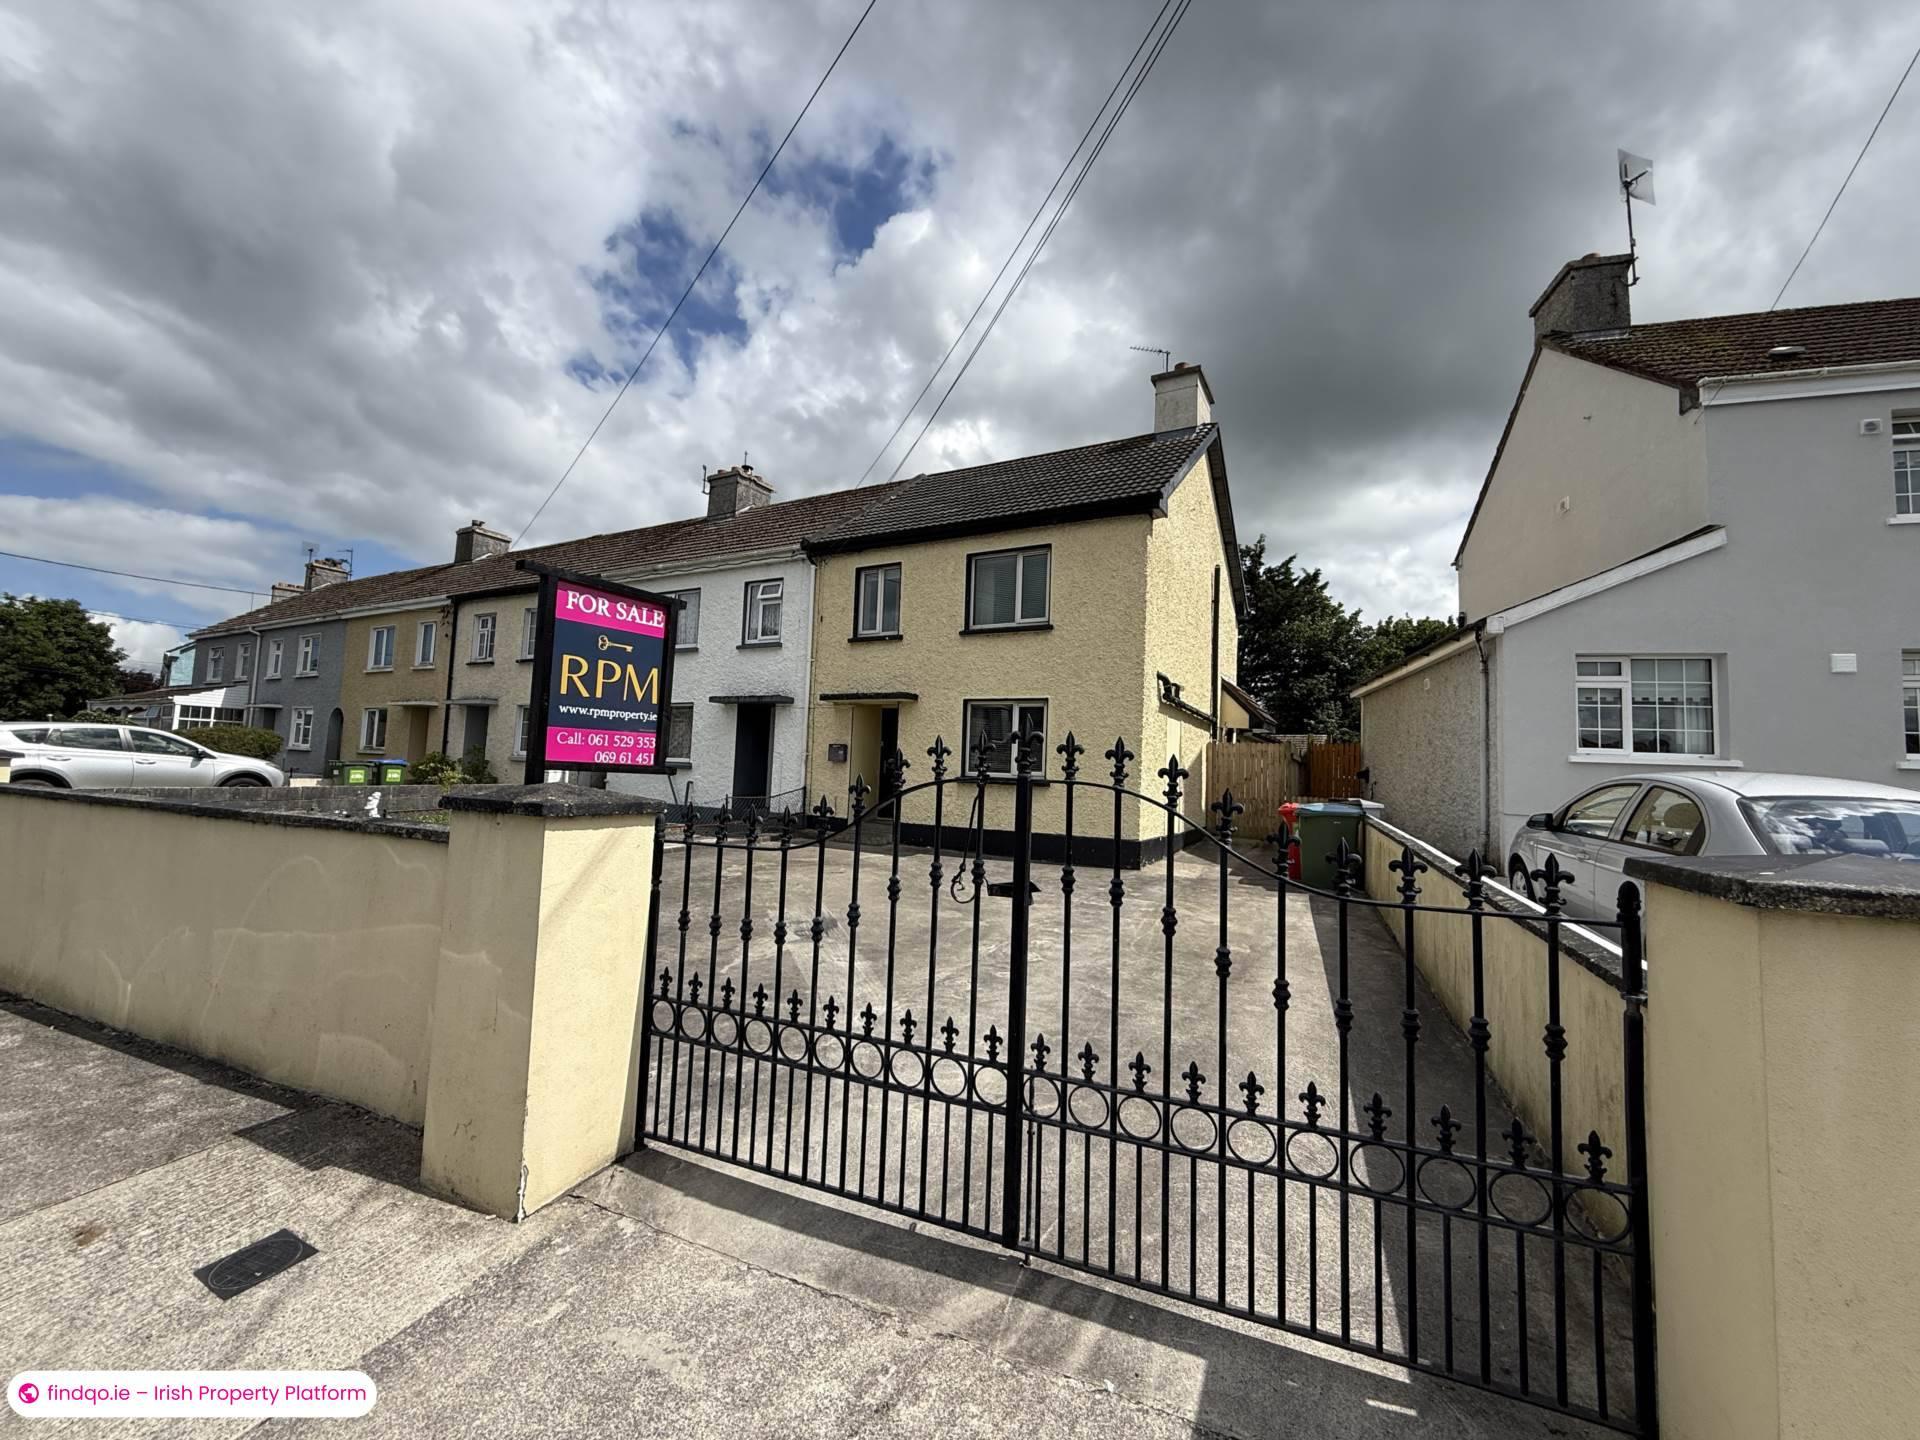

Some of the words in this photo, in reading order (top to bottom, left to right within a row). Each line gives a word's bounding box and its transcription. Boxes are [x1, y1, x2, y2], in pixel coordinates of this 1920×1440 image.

[566, 590, 610, 616] FOR
[616, 602, 665, 627] SALE
[560, 654, 659, 705] RPM
[559, 705, 658, 721] www.rpmproperty.ie
[557, 732, 585, 745] Call:
[588, 734, 609, 746] 061
[613, 735, 634, 747] 529
[637, 737, 656, 749] 353
[594, 751, 616, 763] 069
[619, 752, 632, 764] 61
[636, 753, 655, 765] 451
